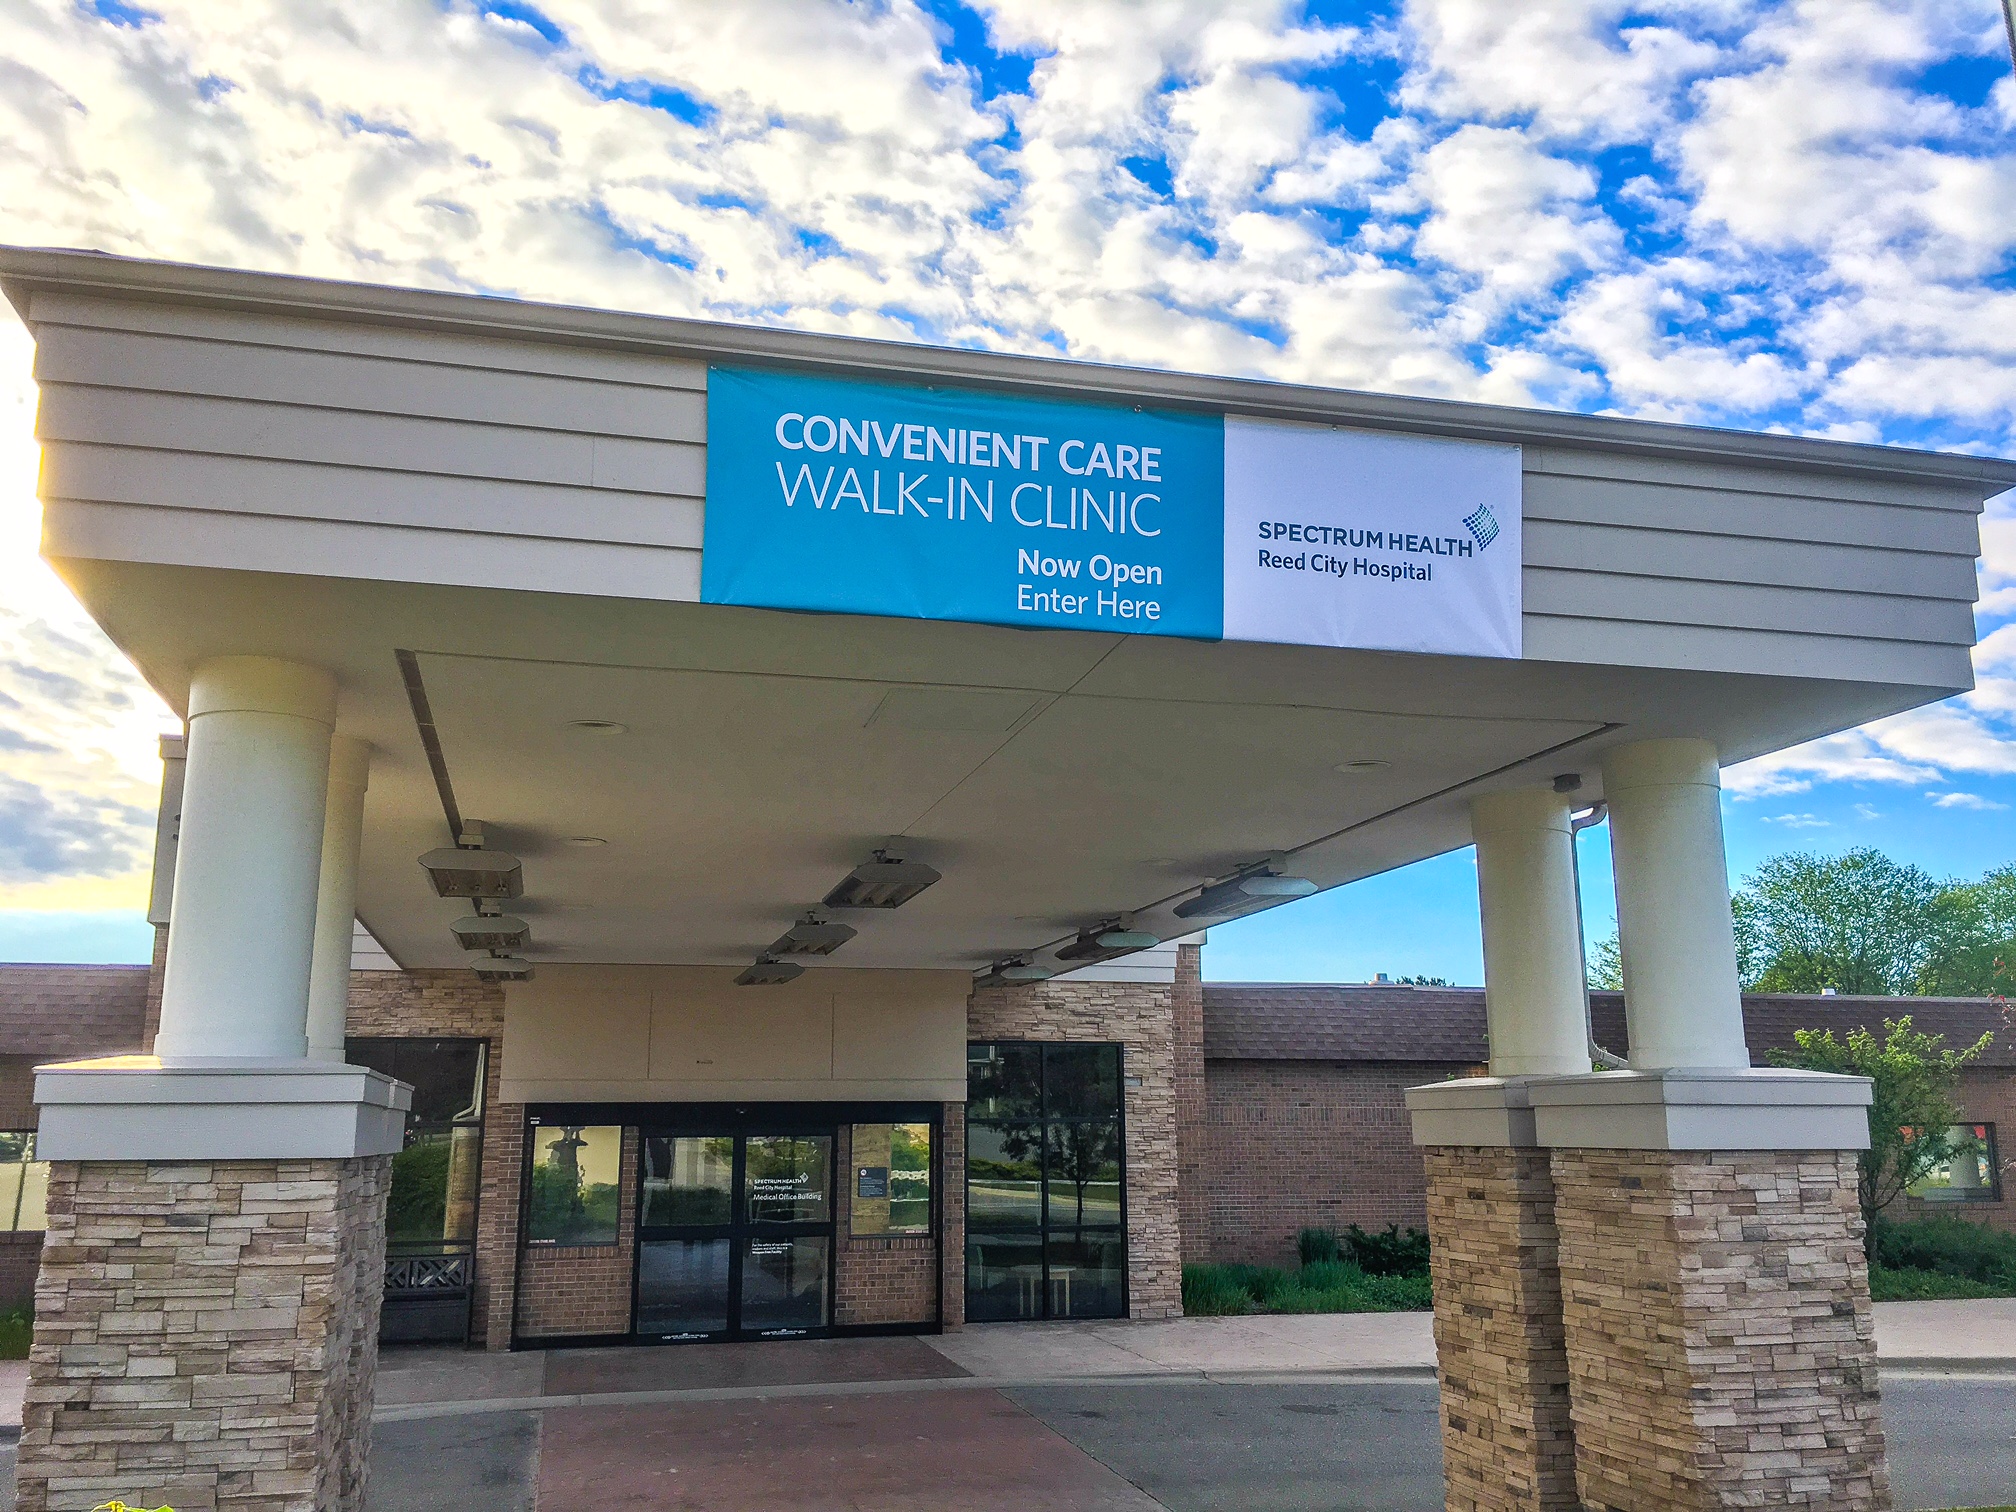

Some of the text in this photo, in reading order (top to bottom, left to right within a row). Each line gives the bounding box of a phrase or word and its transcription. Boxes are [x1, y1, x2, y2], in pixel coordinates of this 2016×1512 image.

[775, 413, 1162, 482] CONVENIENT CARE
[775, 461, 1162, 537] WALK-IN CLINIC
[1258, 521, 1473, 558] SPECTRUM HEALTH
[1018, 548, 1162, 587] Now Open
[1258, 549, 1432, 582] Reed City Hospital
[1017, 583, 1161, 620] Enter Here
[797, 1192, 822, 1201] Building
